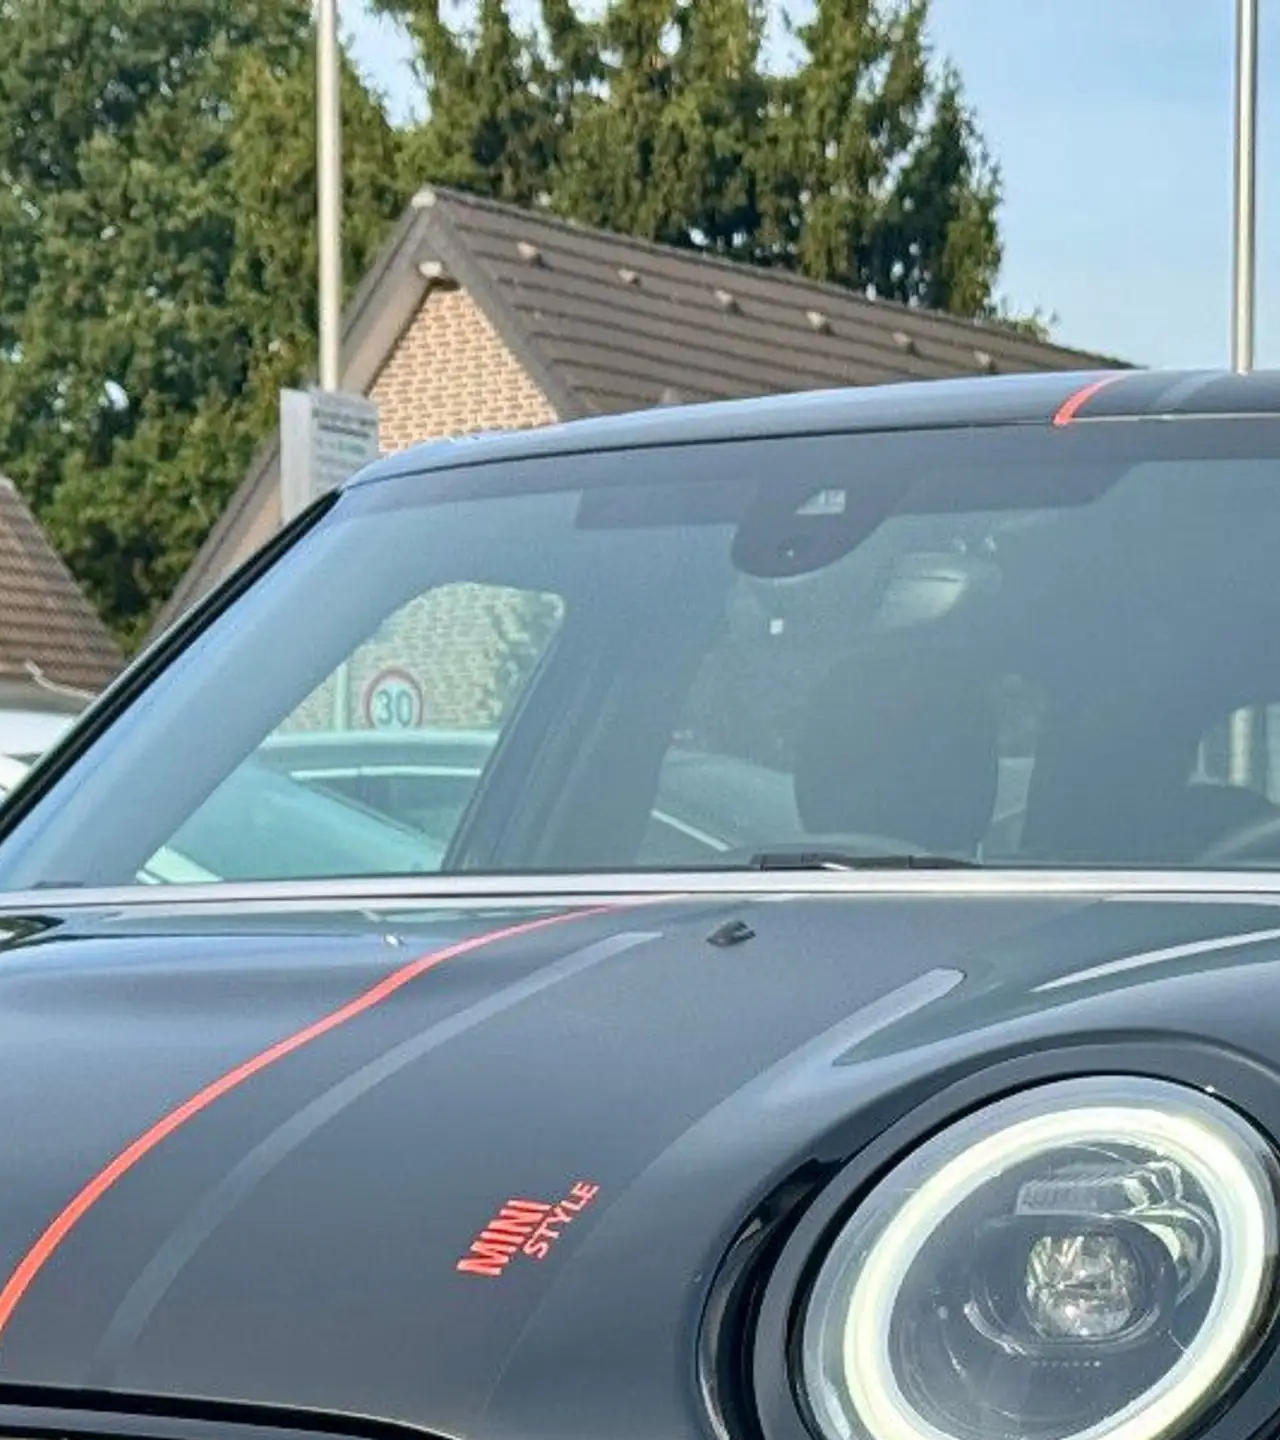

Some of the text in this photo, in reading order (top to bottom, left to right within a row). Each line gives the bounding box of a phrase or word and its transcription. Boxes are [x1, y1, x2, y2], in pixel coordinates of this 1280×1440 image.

[375, 689, 413, 727] 30
[456, 1199, 552, 1277] MINI
[523, 1181, 601, 1260] STYLE
